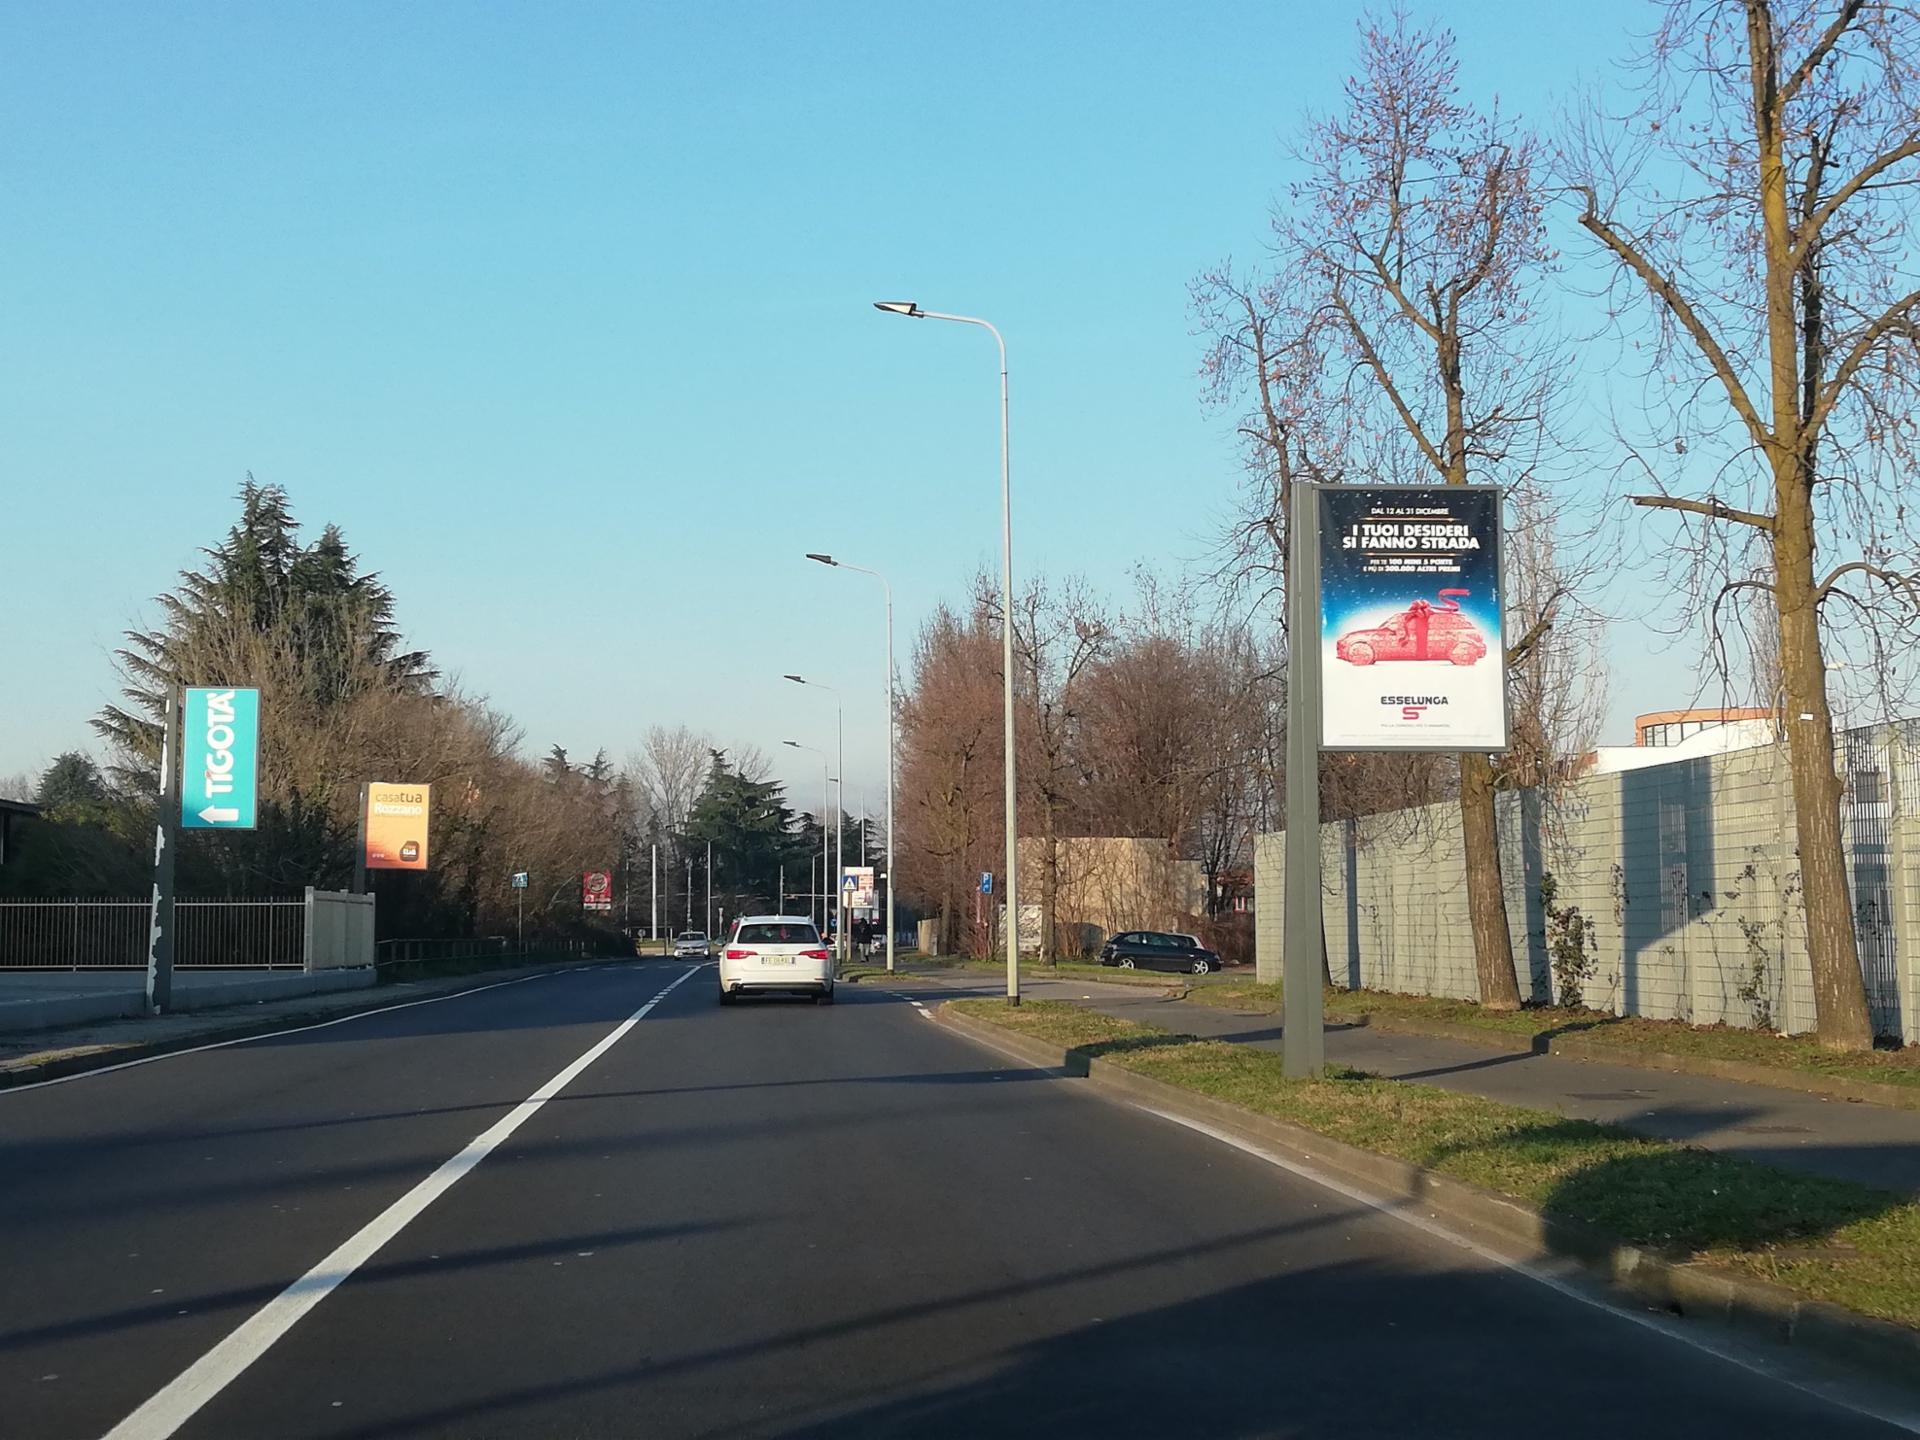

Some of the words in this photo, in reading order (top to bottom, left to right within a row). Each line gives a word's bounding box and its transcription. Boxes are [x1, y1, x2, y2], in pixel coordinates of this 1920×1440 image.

[1371, 507, 1384, 515] DAL
[1386, 507, 1394, 515] 12
[1395, 507, 1404, 515] AL
[1405, 507, 1414, 515] 31
[1415, 507, 1449, 515] DICEMBRE
[1352, 524, 1358, 536] I
[1362, 524, 1399, 536] TUOI
[1403, 524, 1469, 537] DESIDERI
[1342, 537, 1357, 549] SI
[1361, 537, 1418, 549] FANNO
[1421, 537, 1480, 549] STRADA
[1380, 696, 1449, 705] ESSELUNGA
